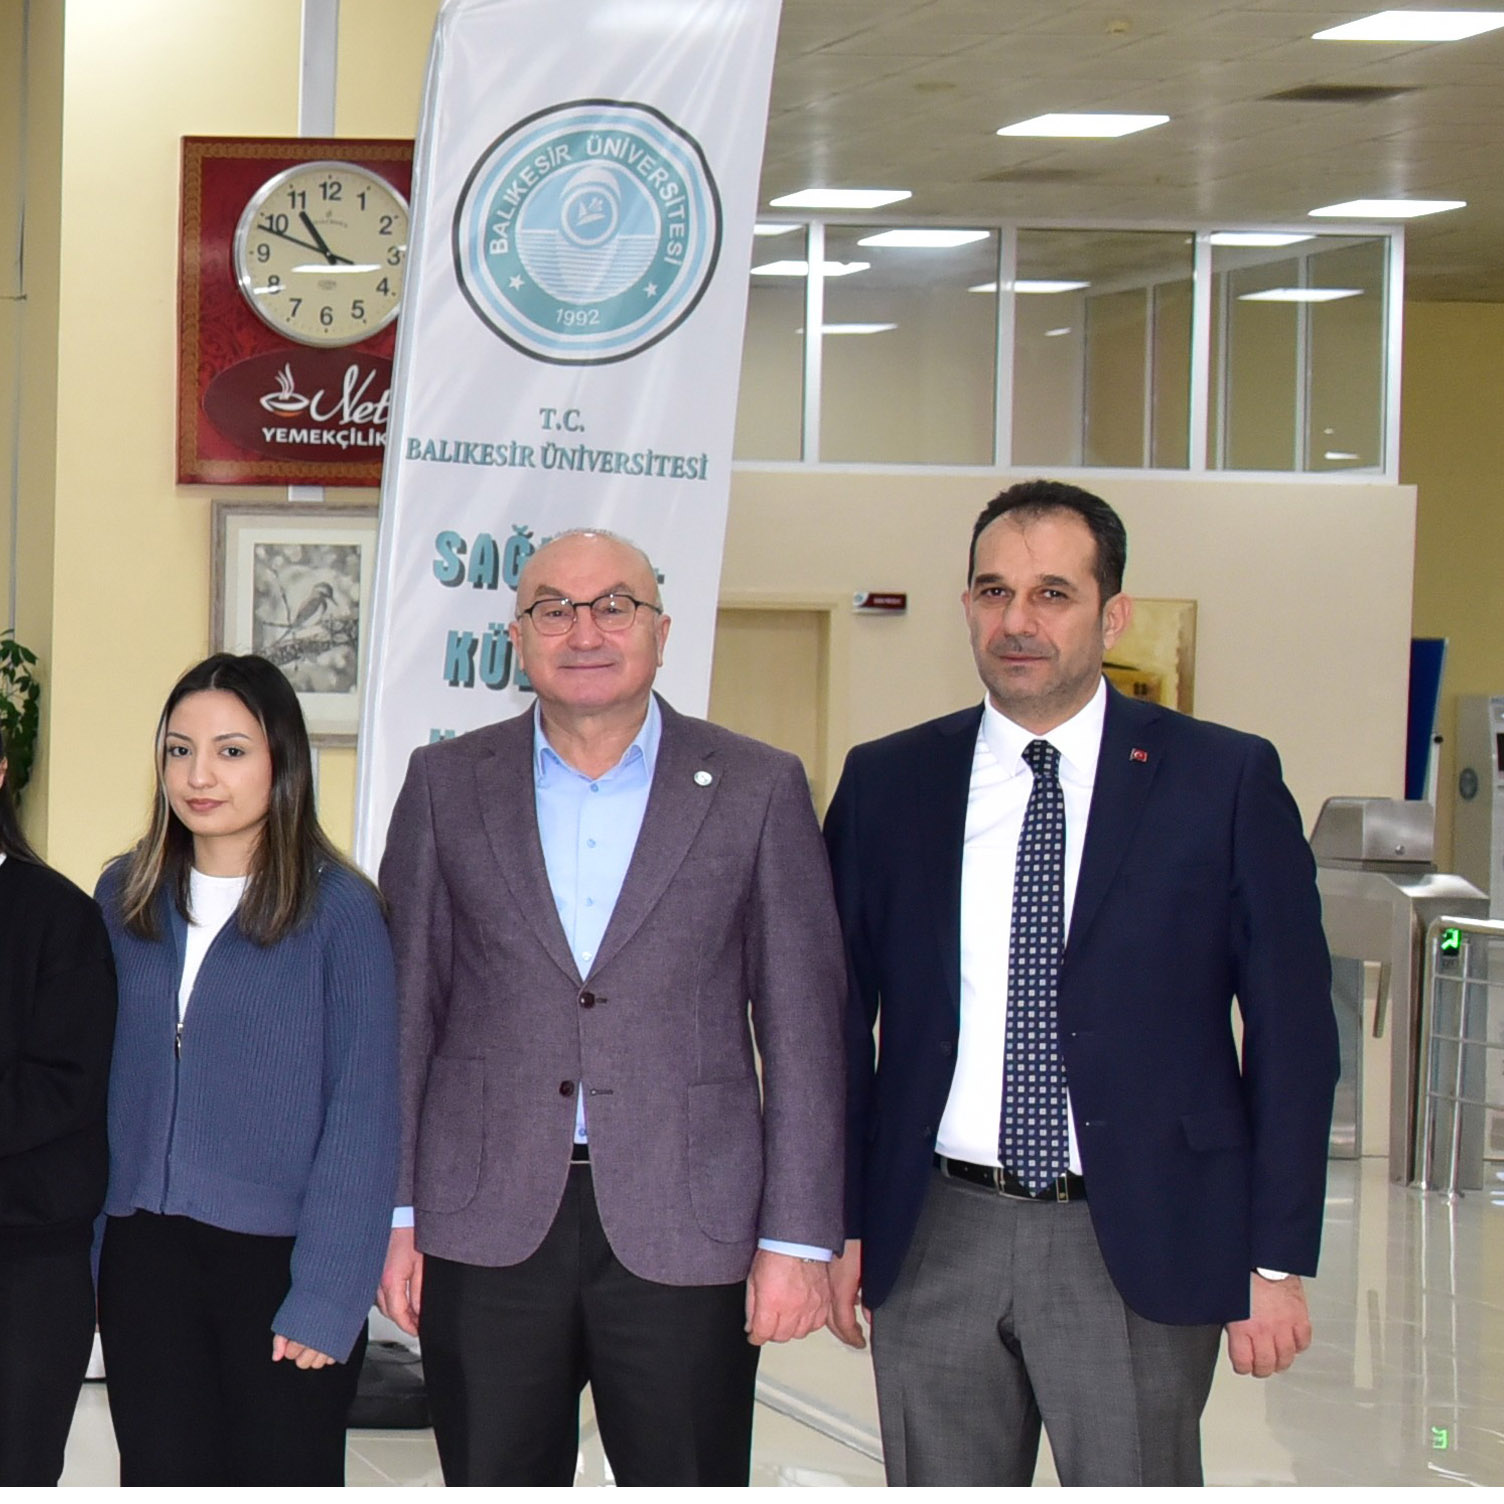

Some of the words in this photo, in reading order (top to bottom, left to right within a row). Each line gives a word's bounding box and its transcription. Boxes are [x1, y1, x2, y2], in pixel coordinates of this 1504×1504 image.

[288, 191, 306, 209] 11
[320, 181, 342, 201] 12
[357, 192, 366, 210] 1
[489, 144, 571, 255] BALIKESİR
[586, 136, 685, 266] ÜNİVERSİTESİ
[266, 214, 288, 234] 10
[379, 216, 392, 235] 2
[257, 244, 270, 262] 9
[387, 246, 401, 265] 3
[267, 275, 280, 294] 8
[376, 277, 389, 296] 4
[289, 298, 302, 317] 7
[320, 307, 333, 326] 6
[351, 300, 364, 319] 5
[556, 309, 600, 326] 1992
[311, 364, 390, 426] Net
[539, 407, 585, 432] T.C.
[406, 437, 536, 467] BALIKESİR
[540, 443, 709, 481] ÜNİVERSİTESİ
